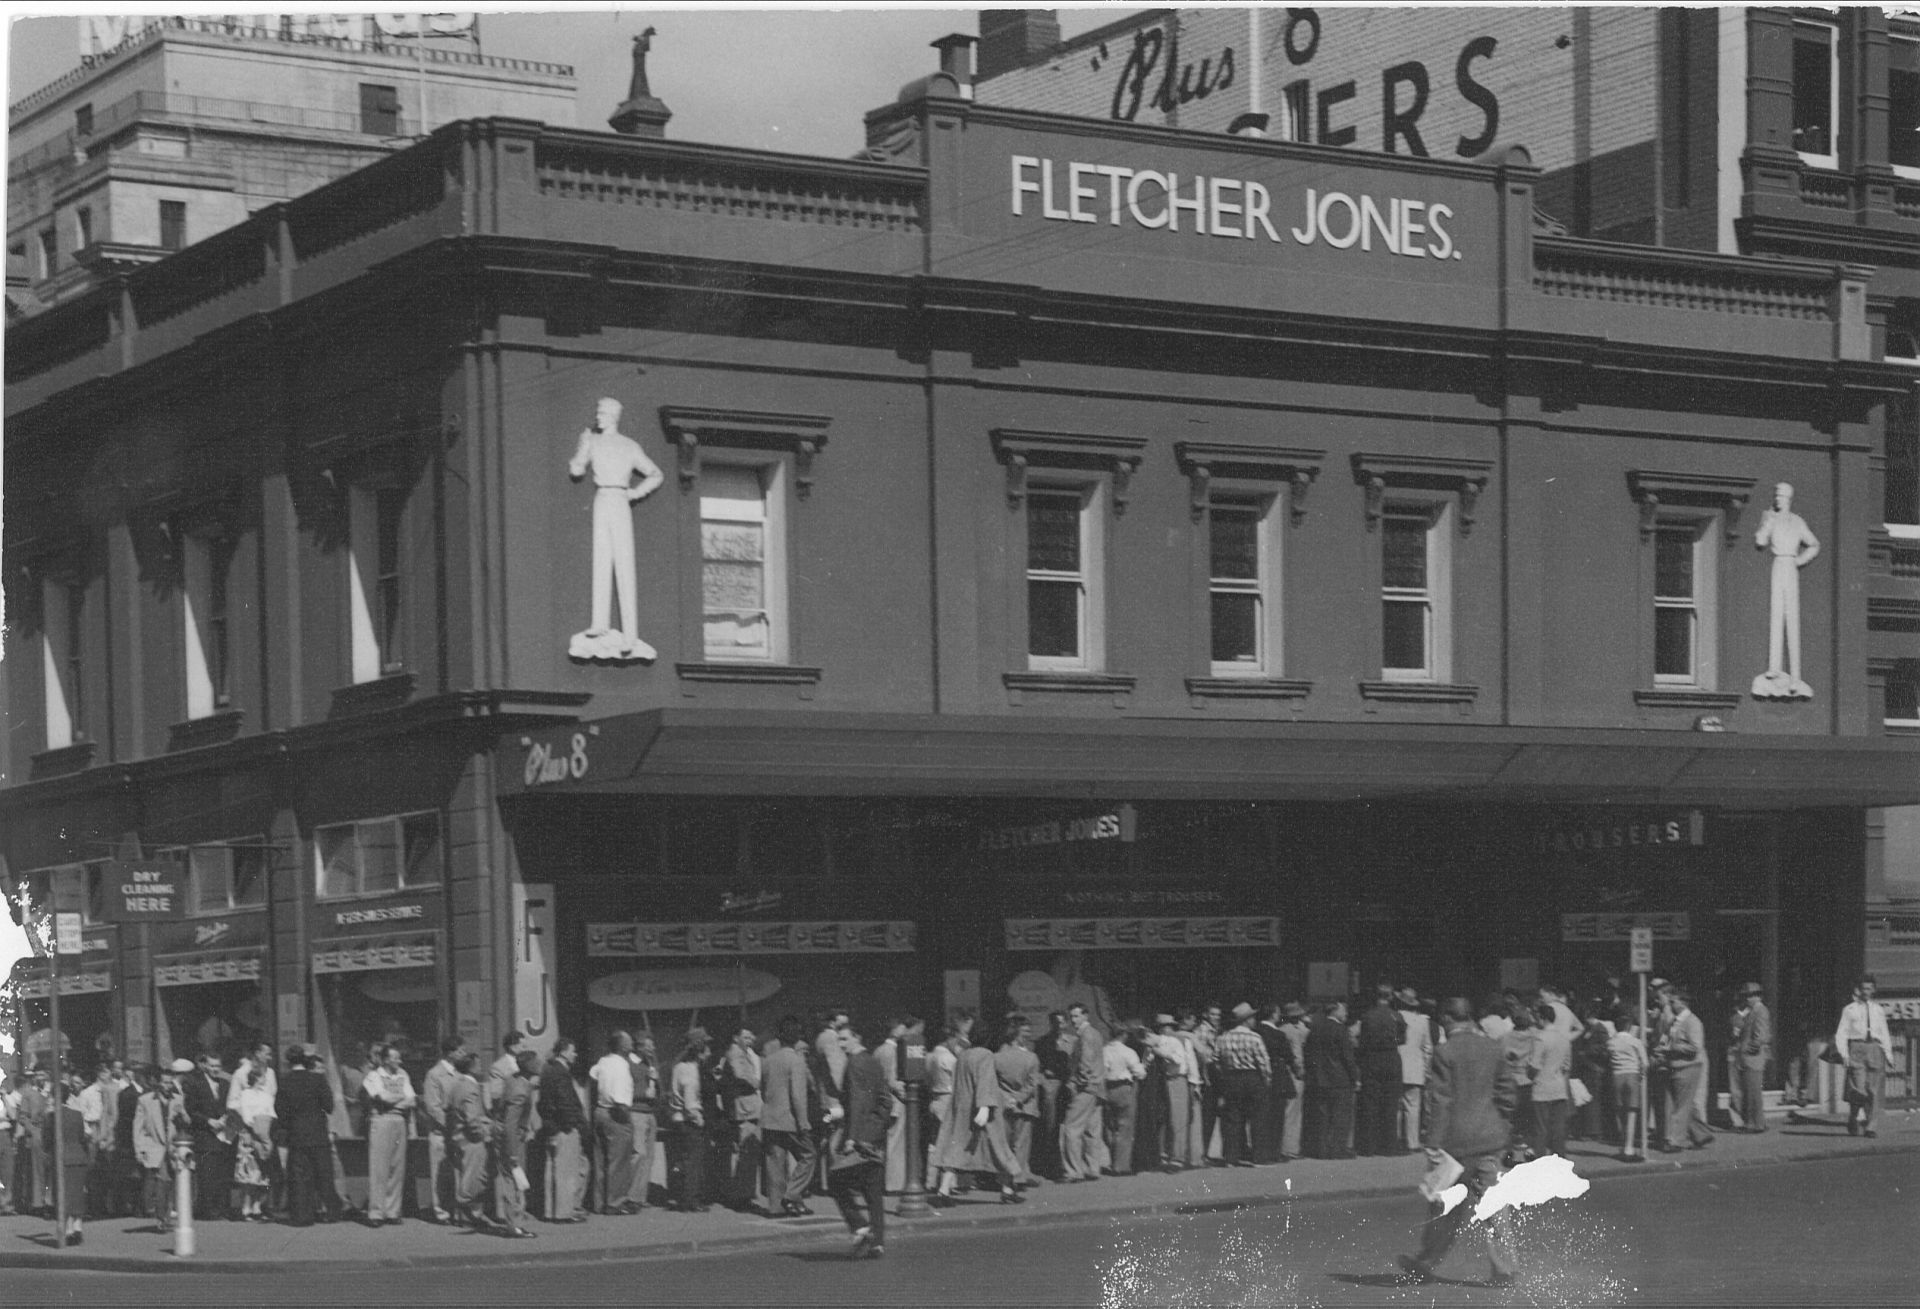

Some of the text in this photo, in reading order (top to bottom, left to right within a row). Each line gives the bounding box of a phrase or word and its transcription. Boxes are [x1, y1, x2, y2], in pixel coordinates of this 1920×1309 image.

[1011, 154, 1463, 261] FLETCHER JONES.
[133, 871, 162, 882] DRY
[121, 884, 175, 895] CLEANING
[126, 897, 171, 912] HERE
